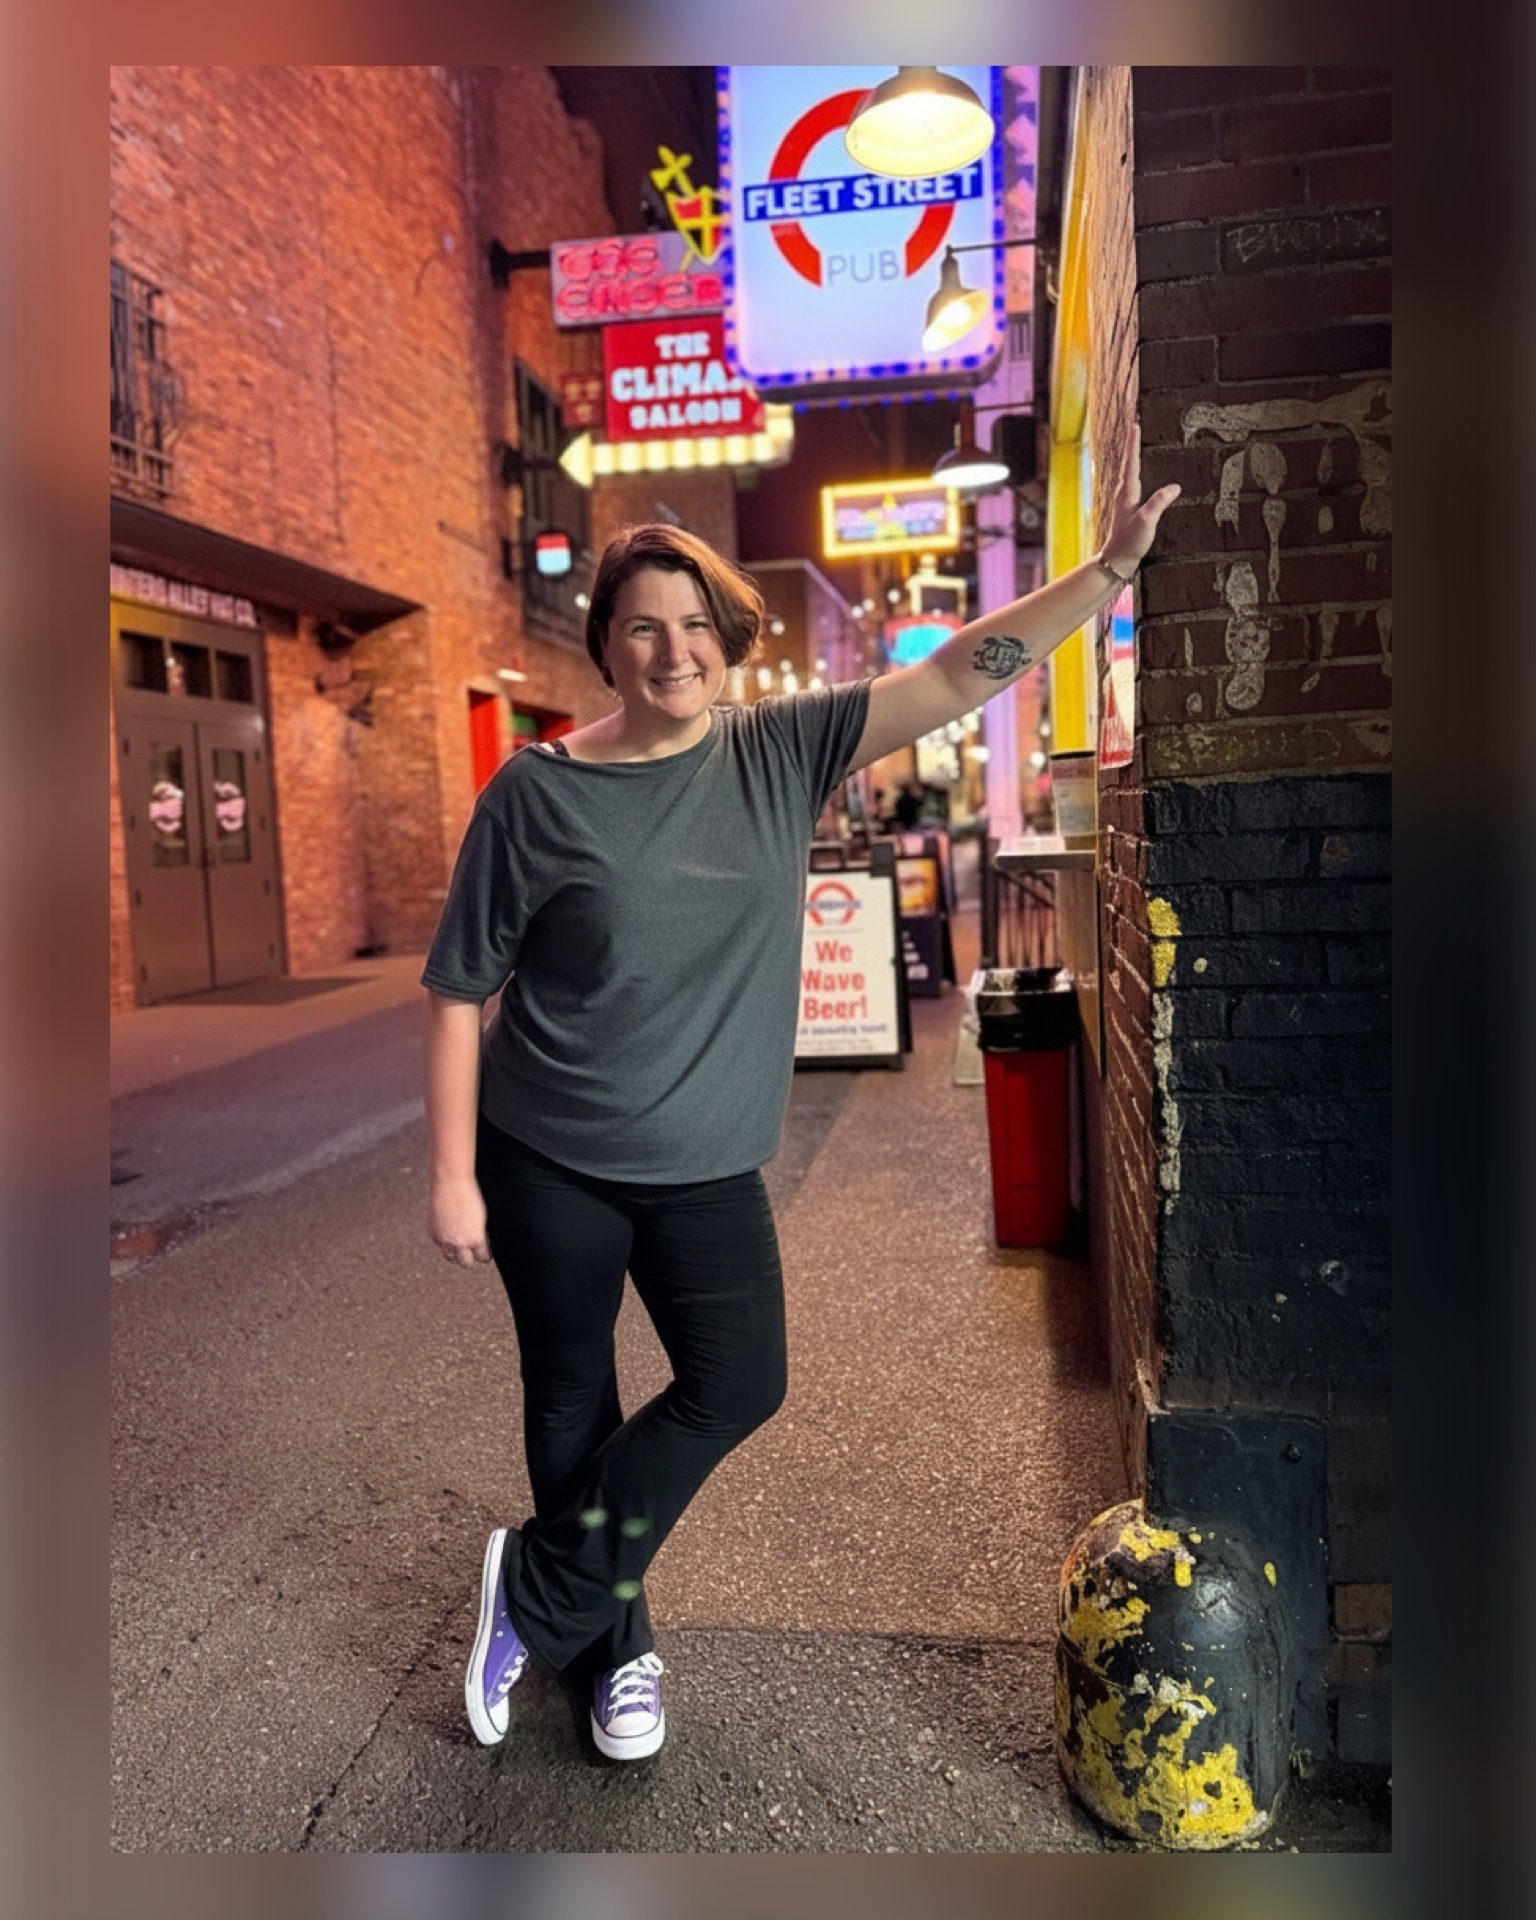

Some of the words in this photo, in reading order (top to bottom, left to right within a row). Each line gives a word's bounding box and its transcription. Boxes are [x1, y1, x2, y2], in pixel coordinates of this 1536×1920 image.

[747, 181, 845, 219] FLEET
[853, 166, 978, 208] STREET
[828, 251, 900, 286] PUB
[655, 332, 710, 359] THE
[629, 397, 742, 430] SALOON
[815, 940, 854, 963] We
[803, 994, 868, 1020] Beer!
